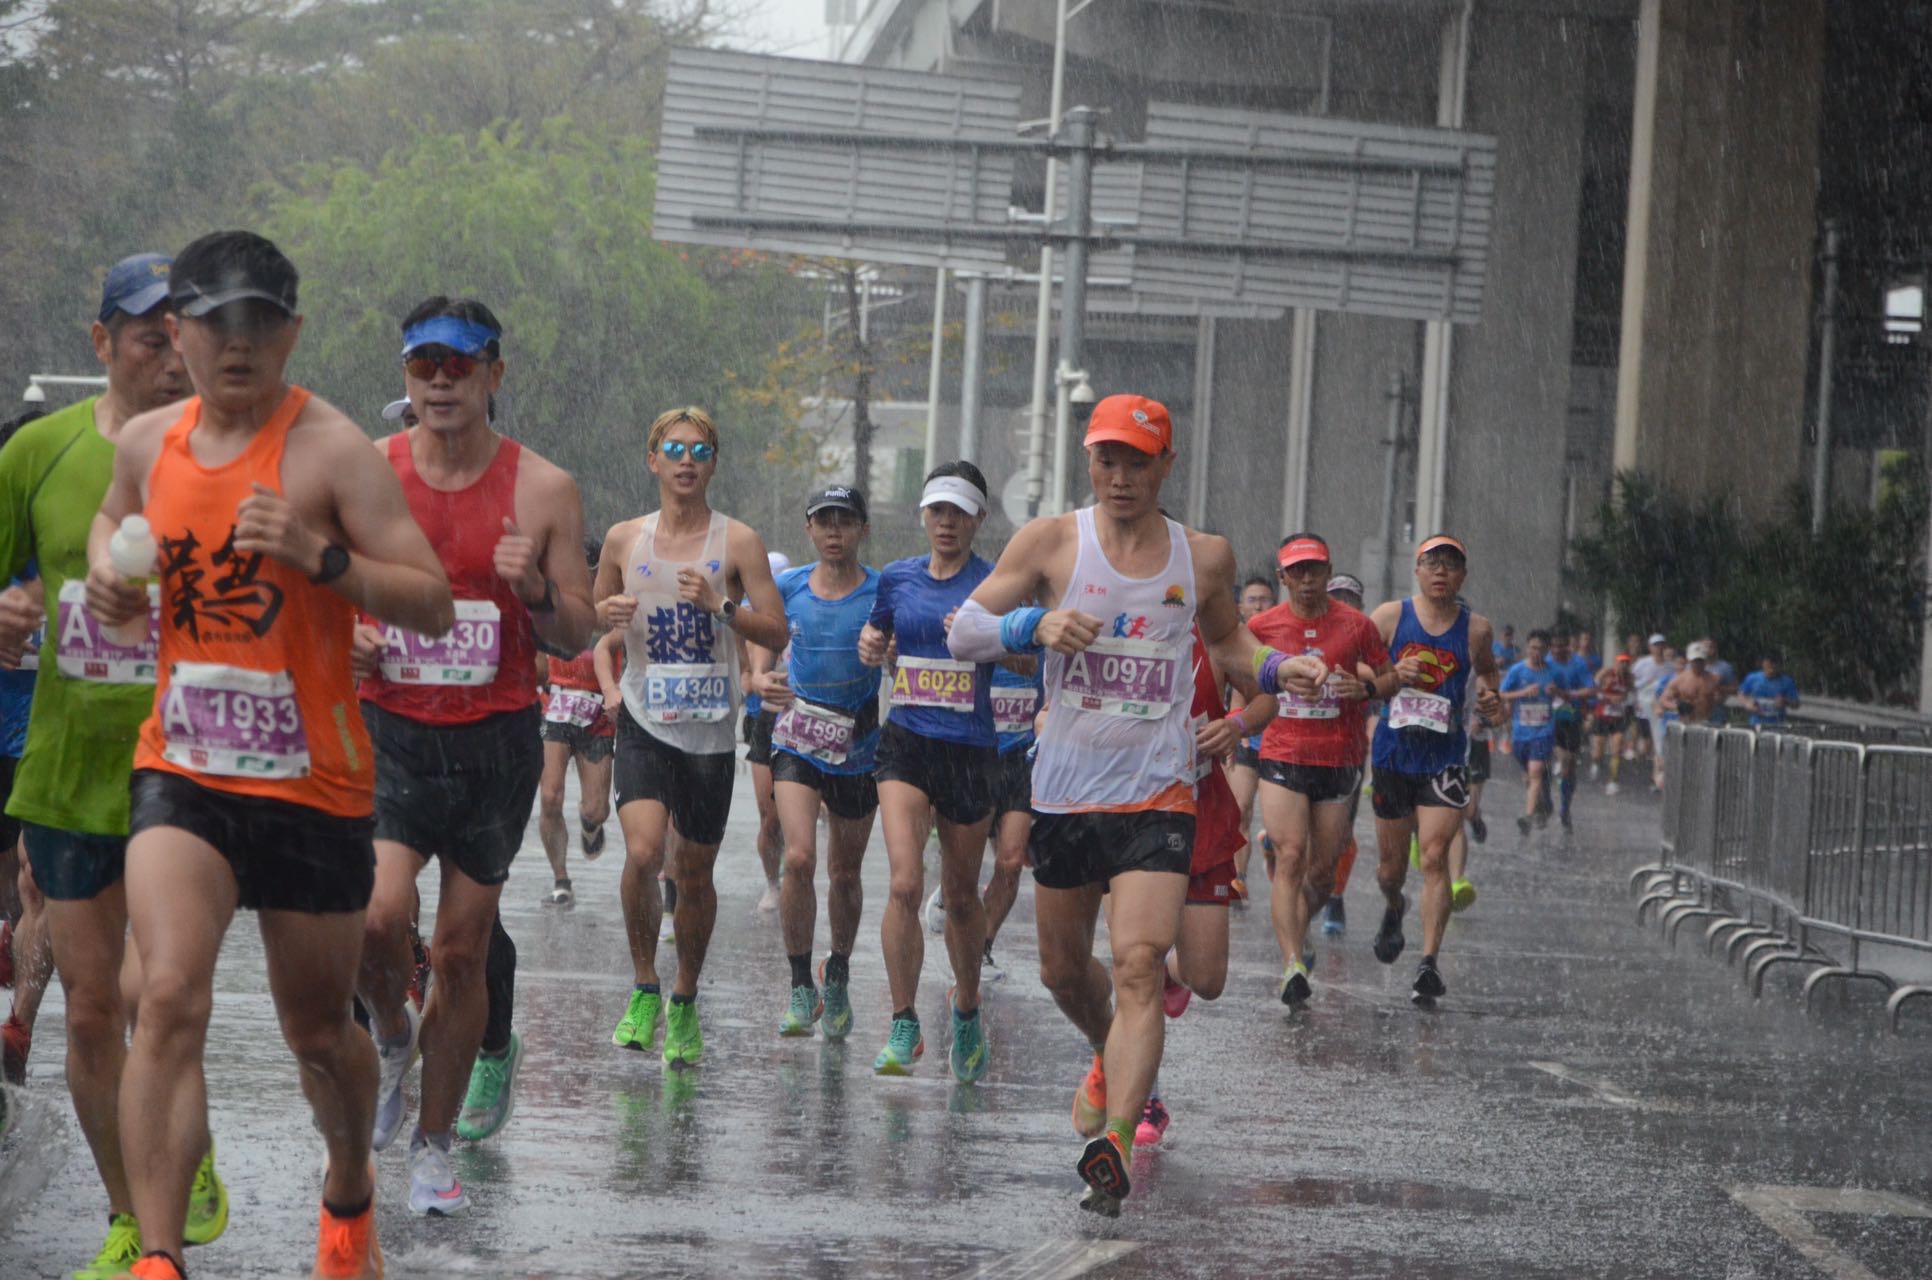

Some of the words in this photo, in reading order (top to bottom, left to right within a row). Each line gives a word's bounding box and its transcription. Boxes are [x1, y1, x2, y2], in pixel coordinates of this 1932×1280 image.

[382, 623, 409, 657] A
[892, 667, 911, 695] A
[918, 670, 972, 692] 6028
[1064, 651, 1092, 686] A
[1102, 656, 1168, 688] 0971
[549, 693, 563, 710] A
[566, 695, 597, 714] 2131
[649, 679, 667, 704] B
[674, 678, 724, 698] 4340
[164, 685, 194, 735] A
[209, 692, 298, 734] 1933
[995, 699, 1035, 715] 0714
[1391, 697, 1403, 714] A
[1410, 698, 1449, 716] 1224
[777, 708, 796, 738] A
[803, 717, 849, 745] 1599
